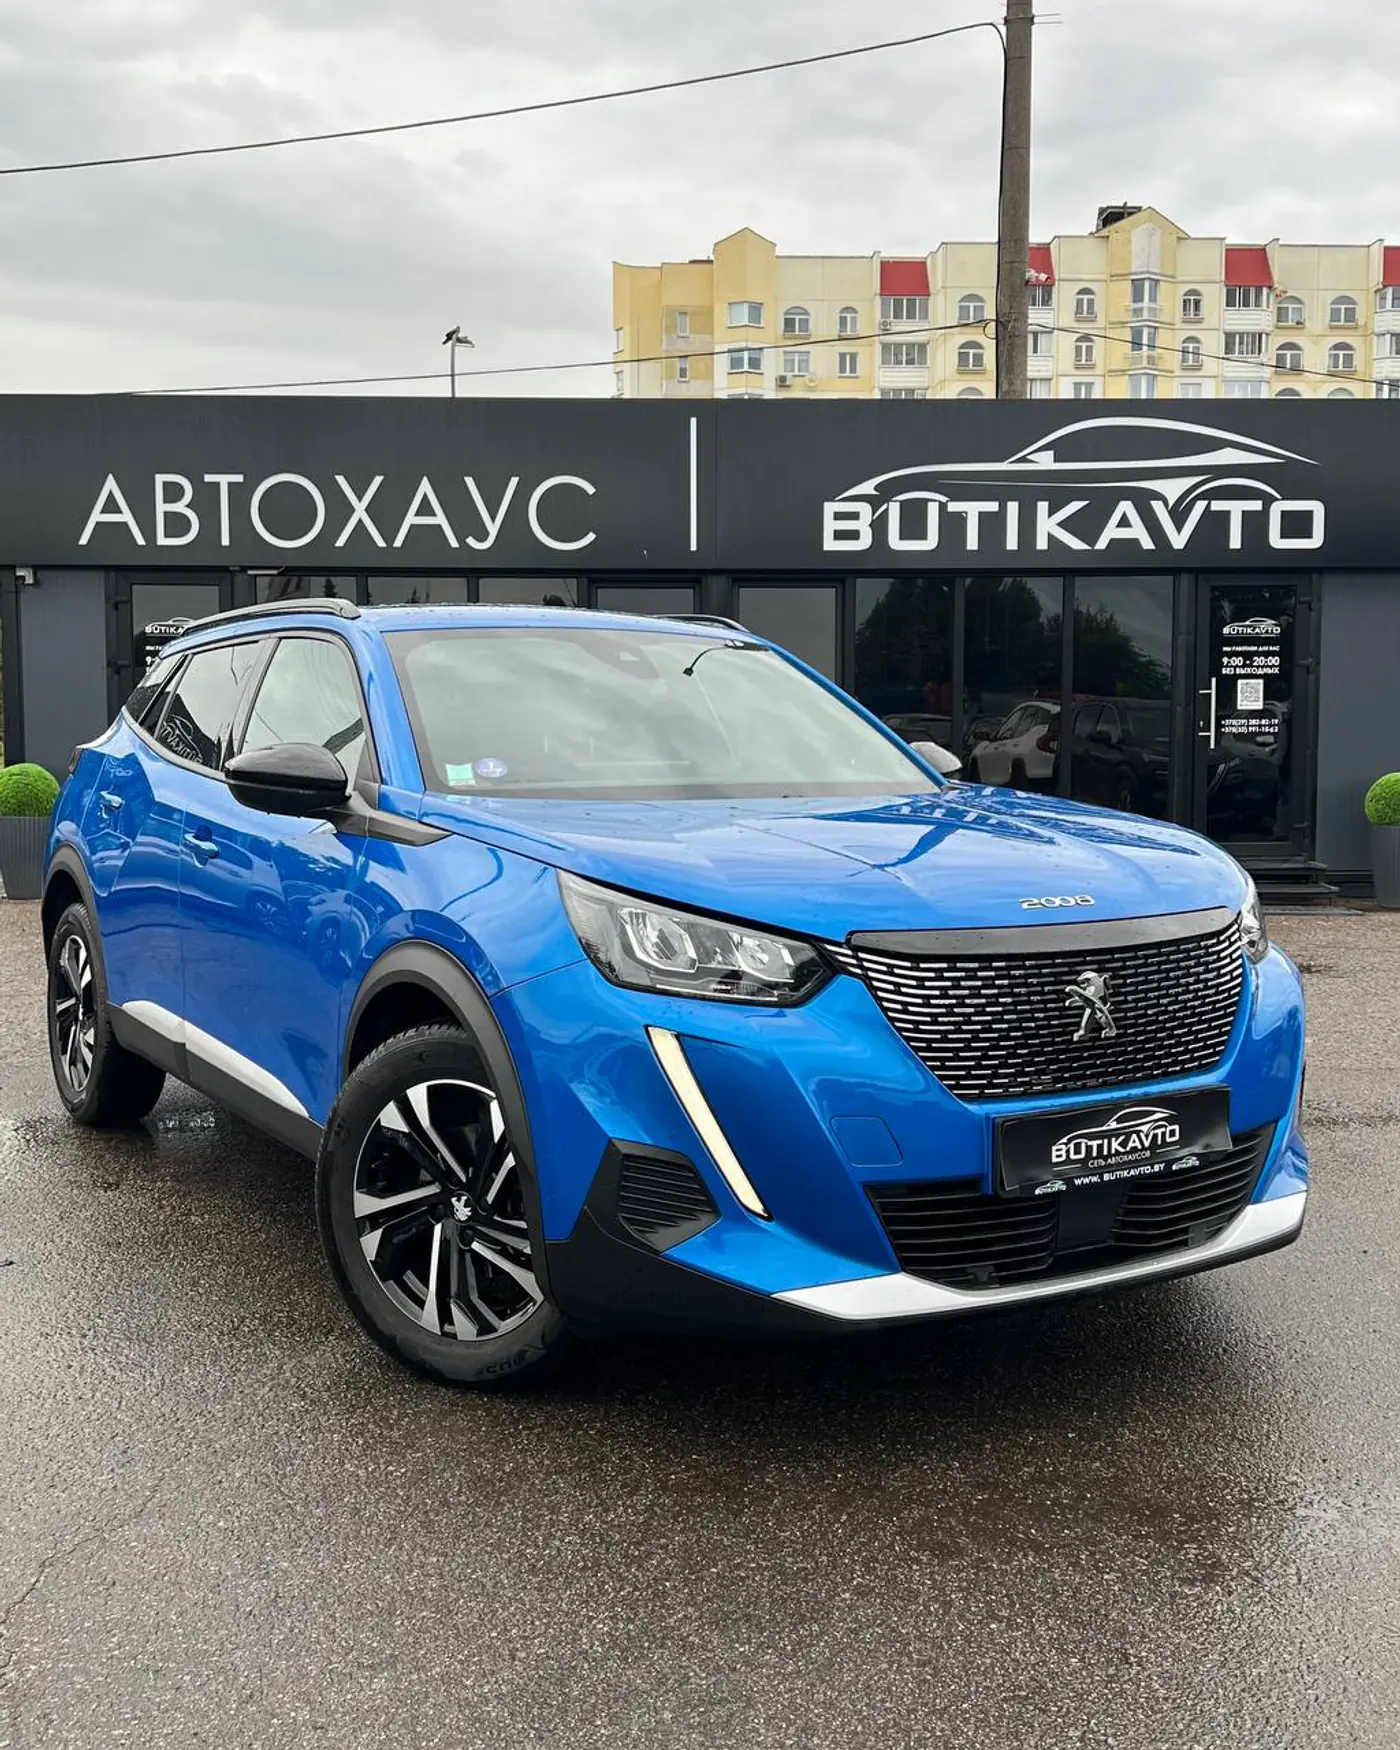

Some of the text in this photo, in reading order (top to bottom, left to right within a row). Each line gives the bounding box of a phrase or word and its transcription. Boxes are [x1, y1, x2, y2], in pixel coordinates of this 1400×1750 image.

[78, 472, 597, 551] АВТОХАУС
[823, 499, 1326, 552] BUTIKAVTO
[144, 625, 184, 634] BUTIKA
[1222, 626, 1281, 635] BUTIKAVTO
[1222, 656, 1244, 666] 9:00
[1252, 656, 1280, 666] 20:00
[1019, 895, 1095, 909] 2008
[1051, 1124, 1180, 1163] BUTIKAVTO
[1103, 1163, 1166, 1181] BUTIKAVTO.BY
